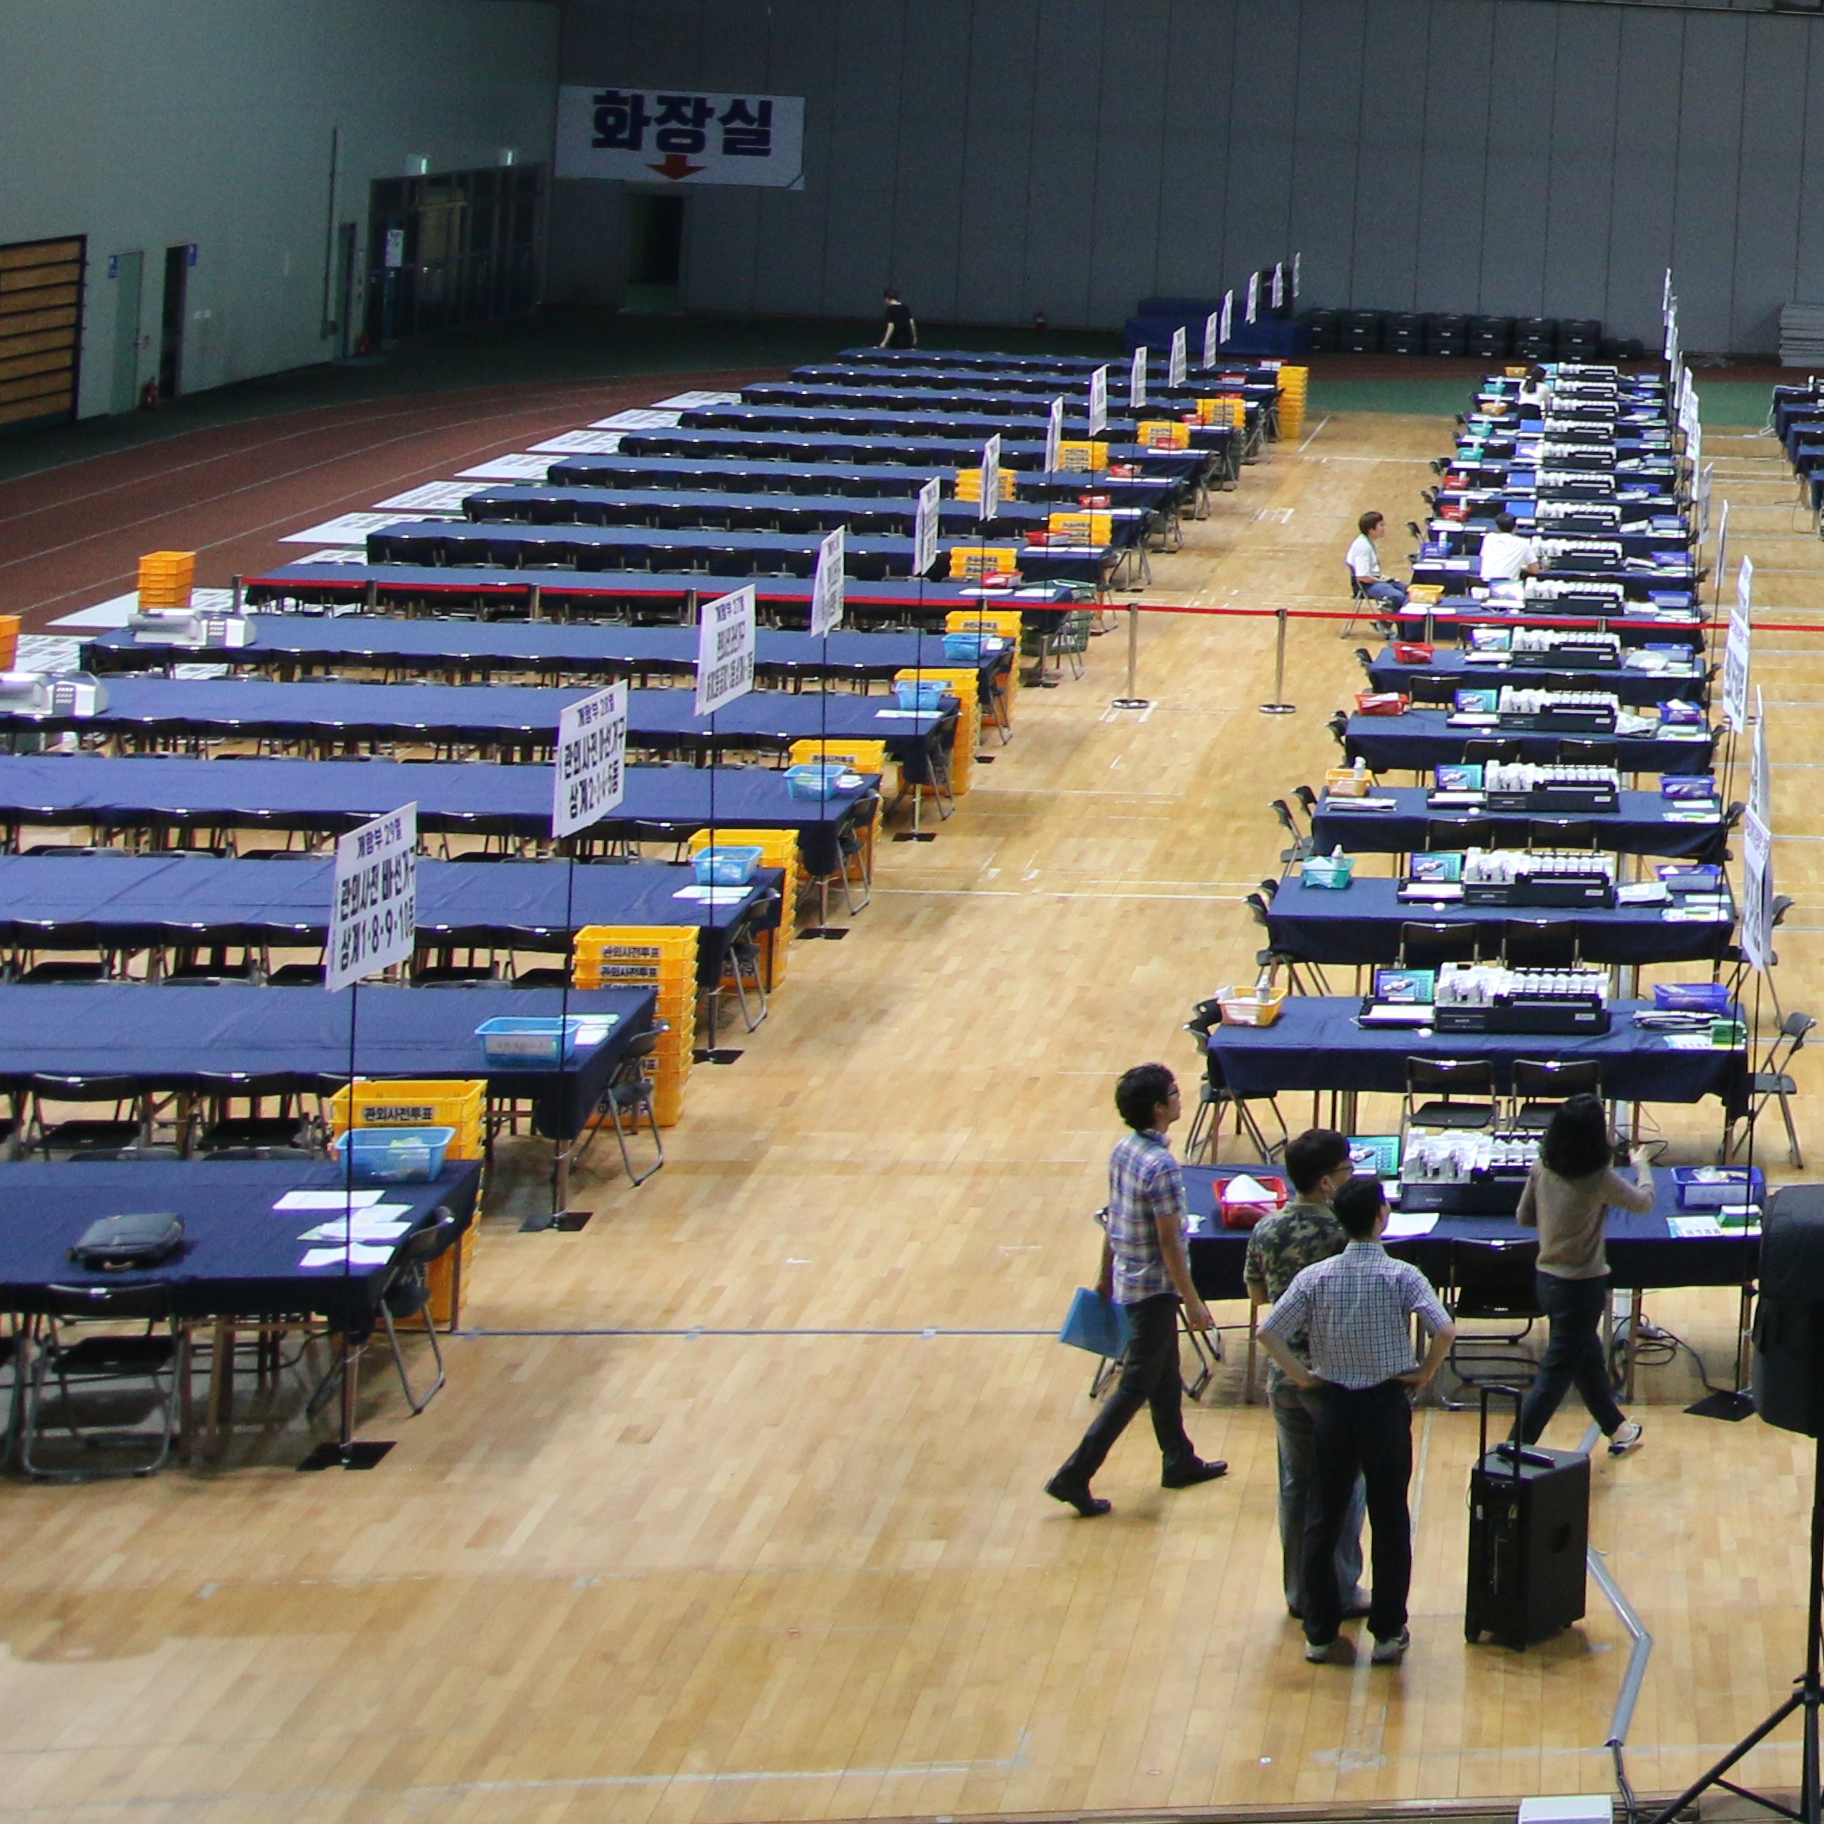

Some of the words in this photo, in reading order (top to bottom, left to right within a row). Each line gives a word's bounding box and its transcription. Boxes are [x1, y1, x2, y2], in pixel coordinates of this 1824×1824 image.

[591, 90, 773, 156] 화장실
[356, 831, 384, 860] 개함부
[340, 862, 380, 923] 관외사전
[364, 1106, 433, 1122] 관외사전투표
